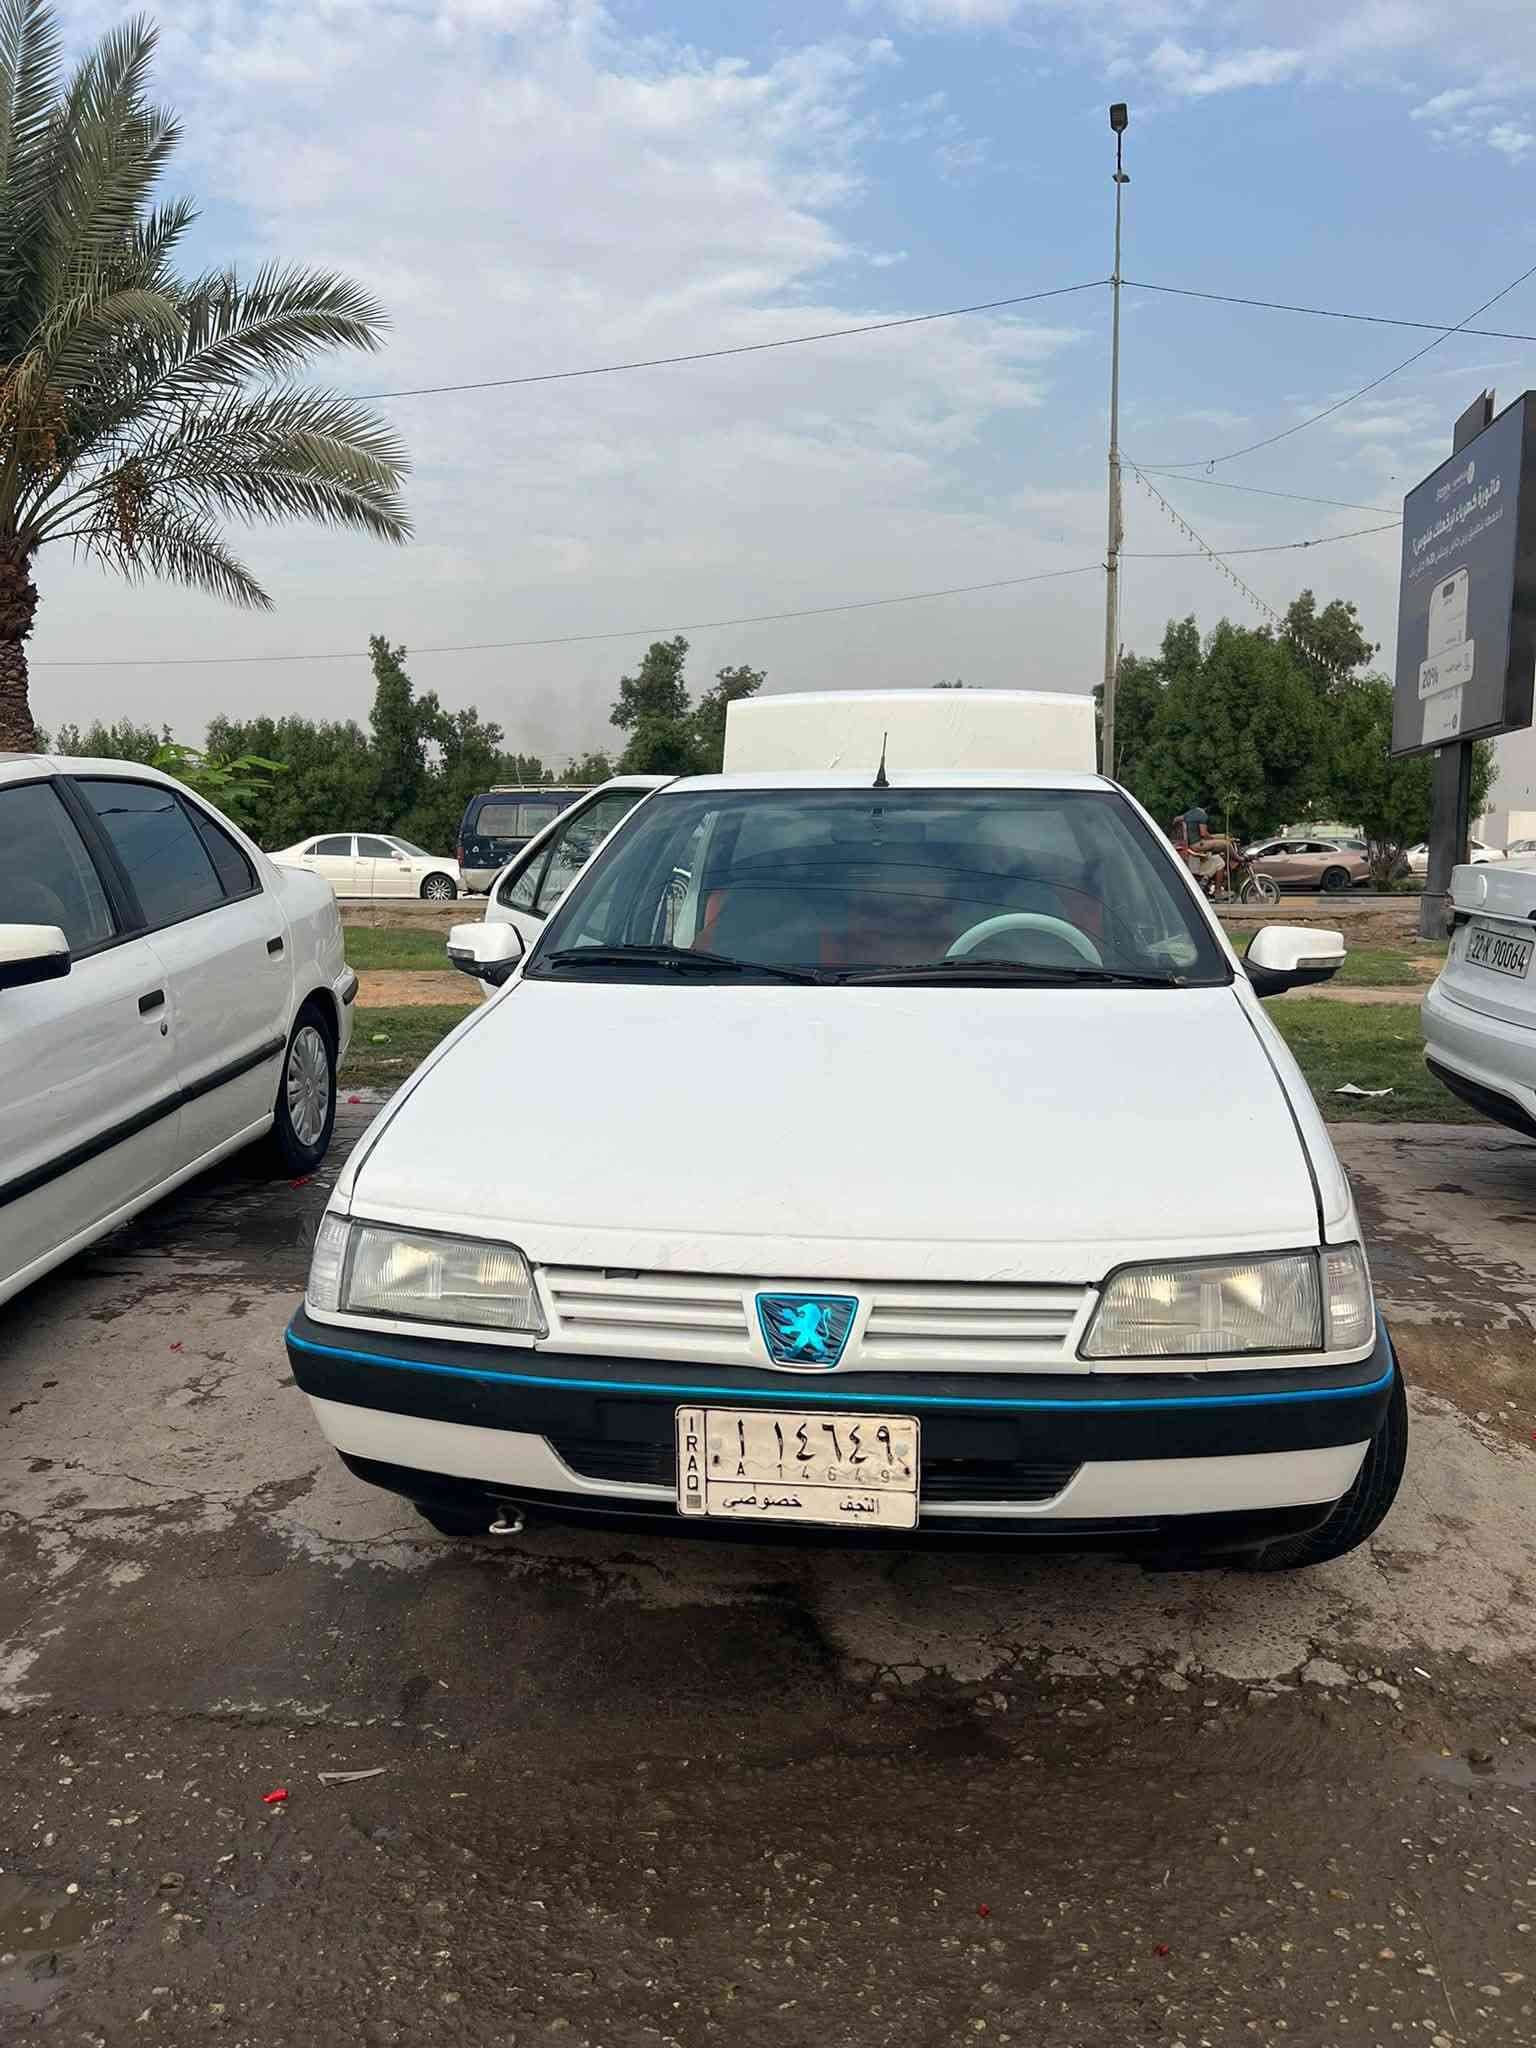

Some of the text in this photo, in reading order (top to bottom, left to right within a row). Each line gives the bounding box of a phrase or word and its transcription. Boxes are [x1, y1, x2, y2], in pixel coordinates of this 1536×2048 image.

[1491, 939, 1527, 972] 90064
[685, 1415, 700, 1492] IRAQ
[736, 1461, 746, 1477] A
